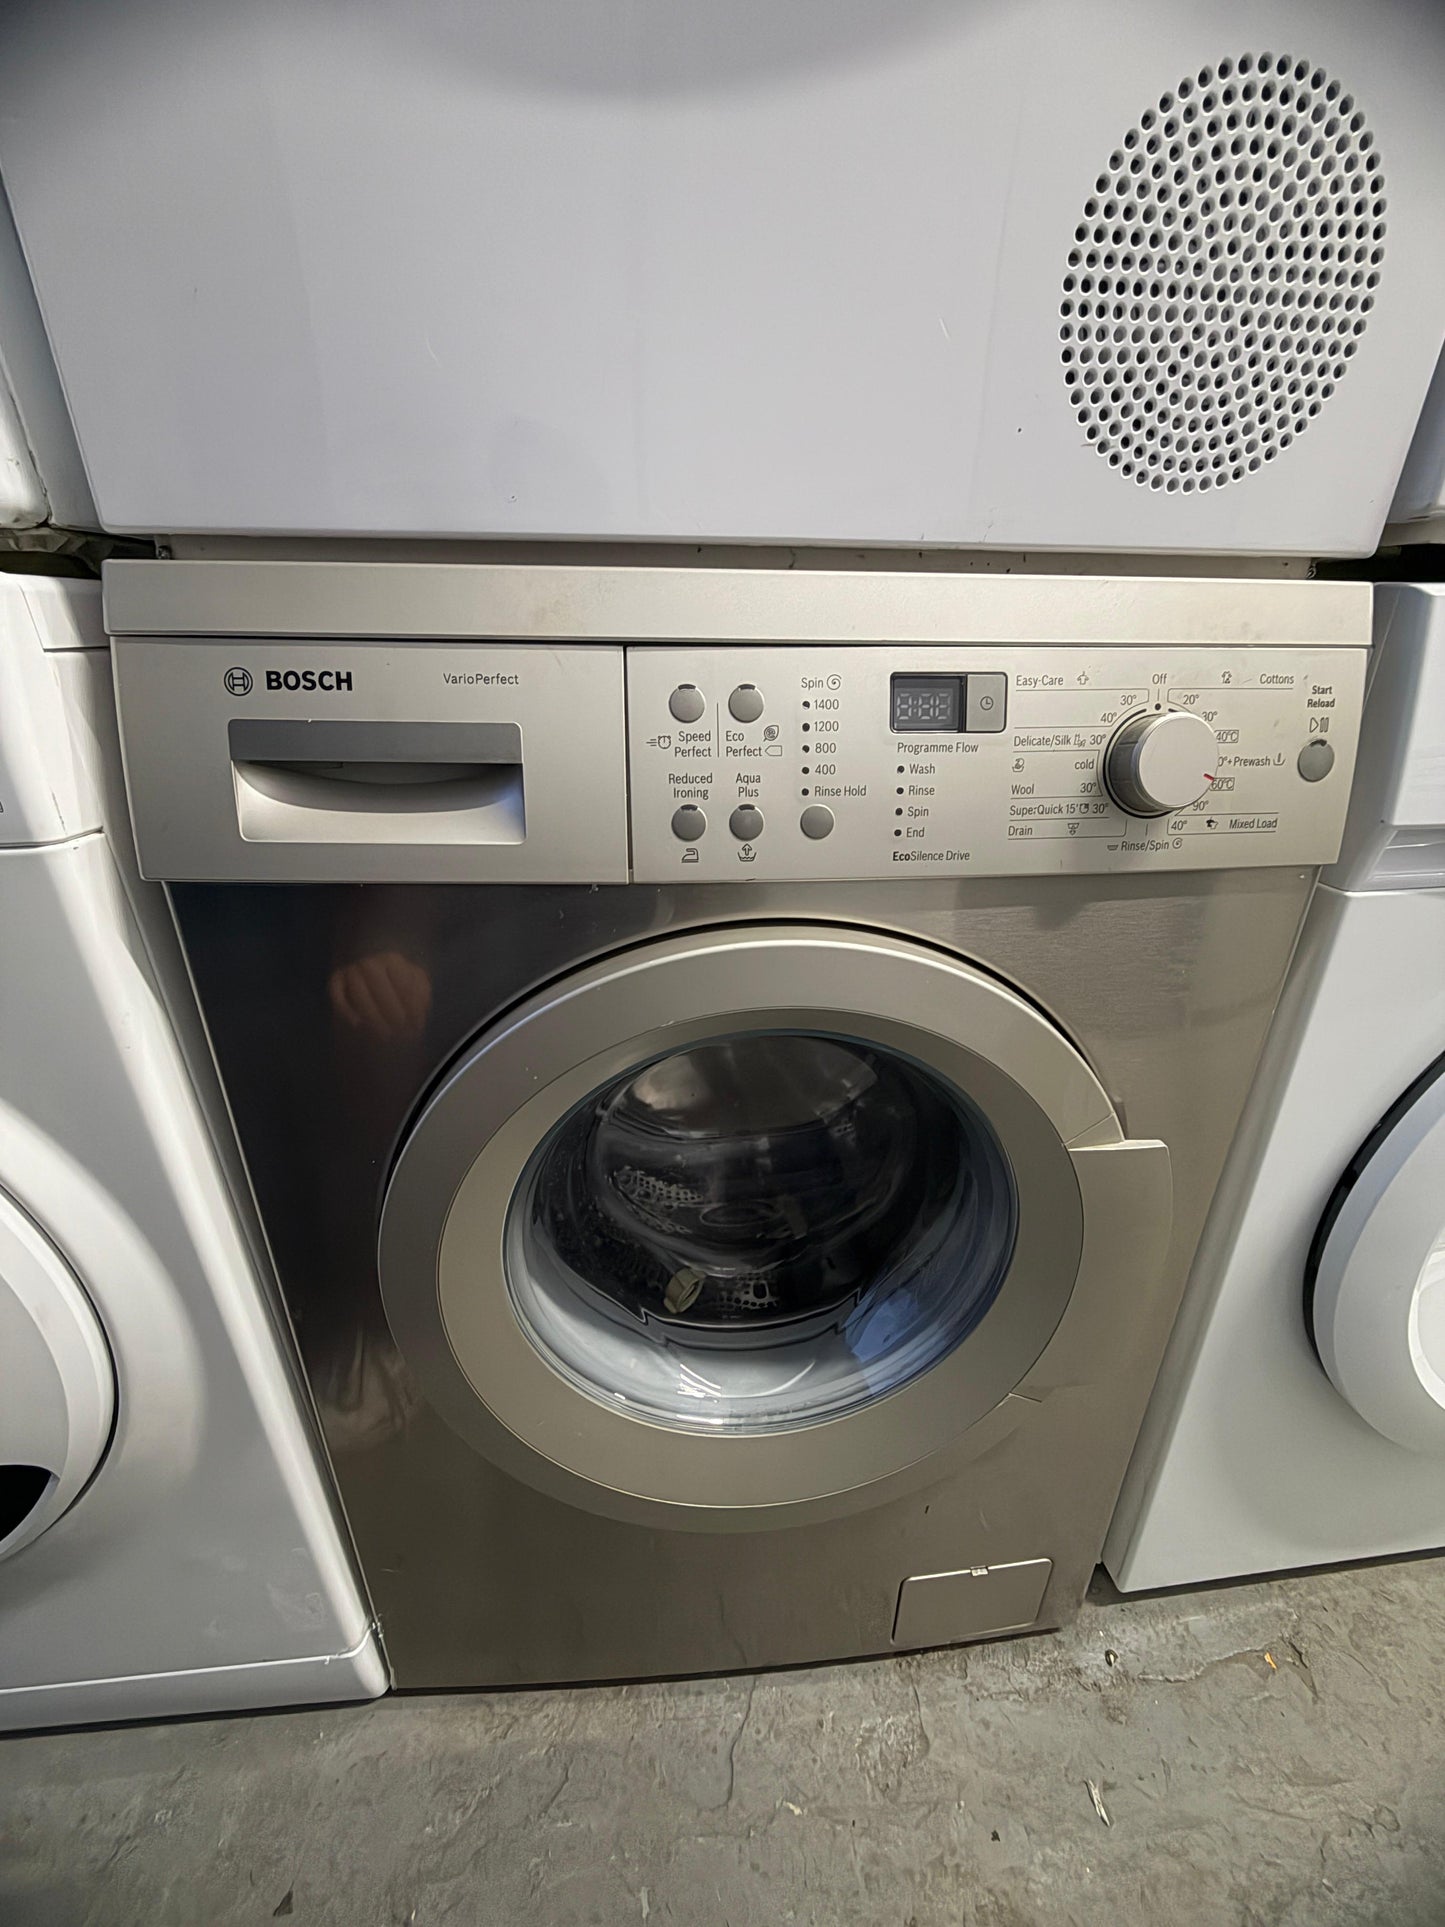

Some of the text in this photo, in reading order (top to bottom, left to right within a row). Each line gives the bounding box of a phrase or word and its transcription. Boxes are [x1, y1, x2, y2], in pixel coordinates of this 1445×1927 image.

[265, 670, 353, 691] BOSCH
[443, 672, 519, 685] VarioPerfect
[801, 677, 824, 690] Spin
[1016, 675, 1064, 688] Easy-Care
[1152, 673, 1167, 685] Off
[1259, 674, 1294, 685] Cottons
[1312, 685, 1333, 695] Start
[814, 699, 840, 710] 1400
[1120, 694, 1137, 706] 30°
[1307, 699, 1335, 709] Reload
[1100, 712, 1117, 724] 40°
[814, 720, 840, 732] 1200
[678, 731, 711, 744] Speed
[726, 731, 744, 742] Eco
[1014, 735, 1071, 747] Delicate/Silk
[674, 745, 712, 758] Perfect
[726, 745, 762, 758] Perfect
[815, 742, 837, 753] 800
[897, 743, 979, 755] Programme Flow
[1075, 760, 1094, 769] cold
[1234, 756, 1271, 767] Prewash
[815, 764, 836, 775] 400
[909, 764, 935, 775] Wash
[668, 773, 713, 785] Reduced
[736, 773, 761, 786] Aqua
[673, 787, 709, 800] Ironing
[738, 787, 759, 798] Plus
[814, 785, 867, 797] Rinse Hold
[908, 785, 935, 796] Rinse
[1011, 784, 1034, 795] Wool
[907, 807, 929, 819] Spin
[1008, 825, 1033, 836] Drain
[1171, 818, 1277, 831] 40° Mixed Load
[906, 828, 925, 838] End
[1121, 839, 1169, 852] Rinse/Spin
[892, 850, 970, 862] EcoSilence Drive
